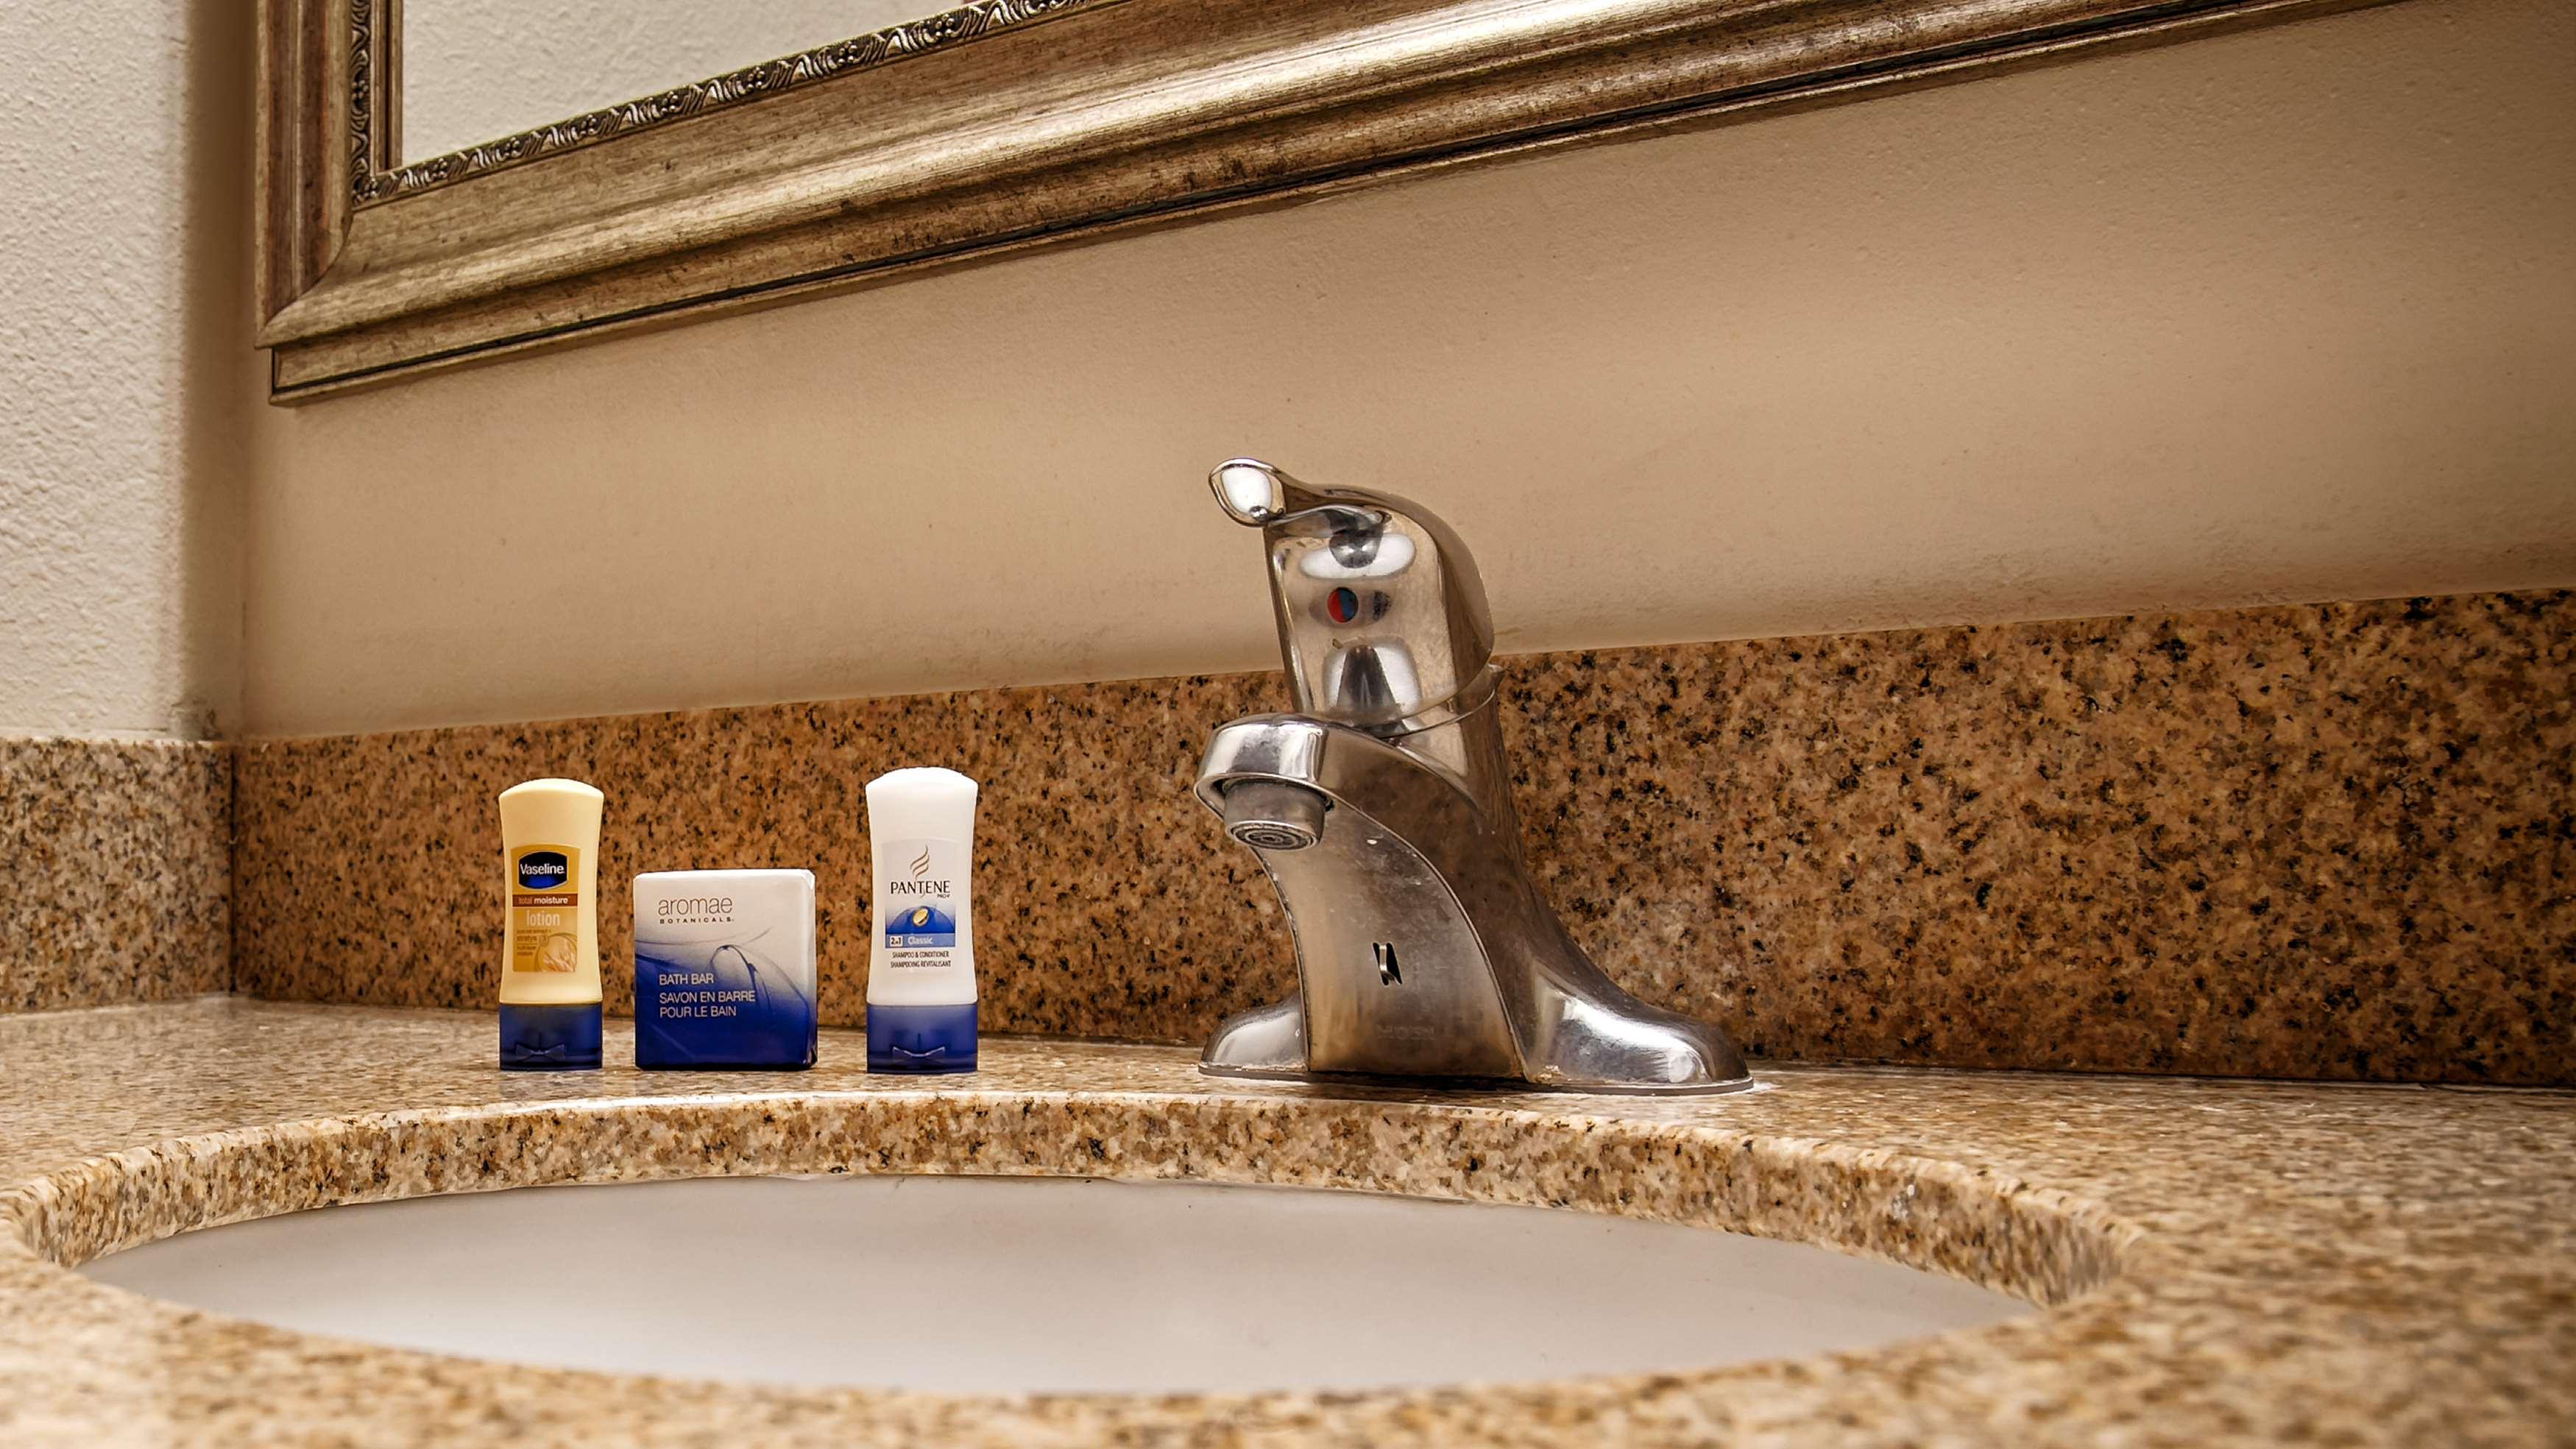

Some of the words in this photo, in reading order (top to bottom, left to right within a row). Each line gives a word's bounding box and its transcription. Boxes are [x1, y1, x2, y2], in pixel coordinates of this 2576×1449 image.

[520, 862, 565, 875] Vaseline
[891, 880, 951, 895] PANTENE
[534, 896, 568, 904] moisture
[658, 897, 733, 916] aromae
[526, 910, 560, 926] lotion
[907, 936, 933, 945] Classic
[659, 974, 688, 985] BATH
[691, 973, 714, 985] BAR
[659, 992, 698, 1005] SAVON
[700, 991, 716, 1002] EN
[718, 990, 756, 1002] BARRE
[659, 1006, 692, 1018] POUR
[694, 1006, 709, 1017] LE
[710, 1005, 737, 1016] BAIN
